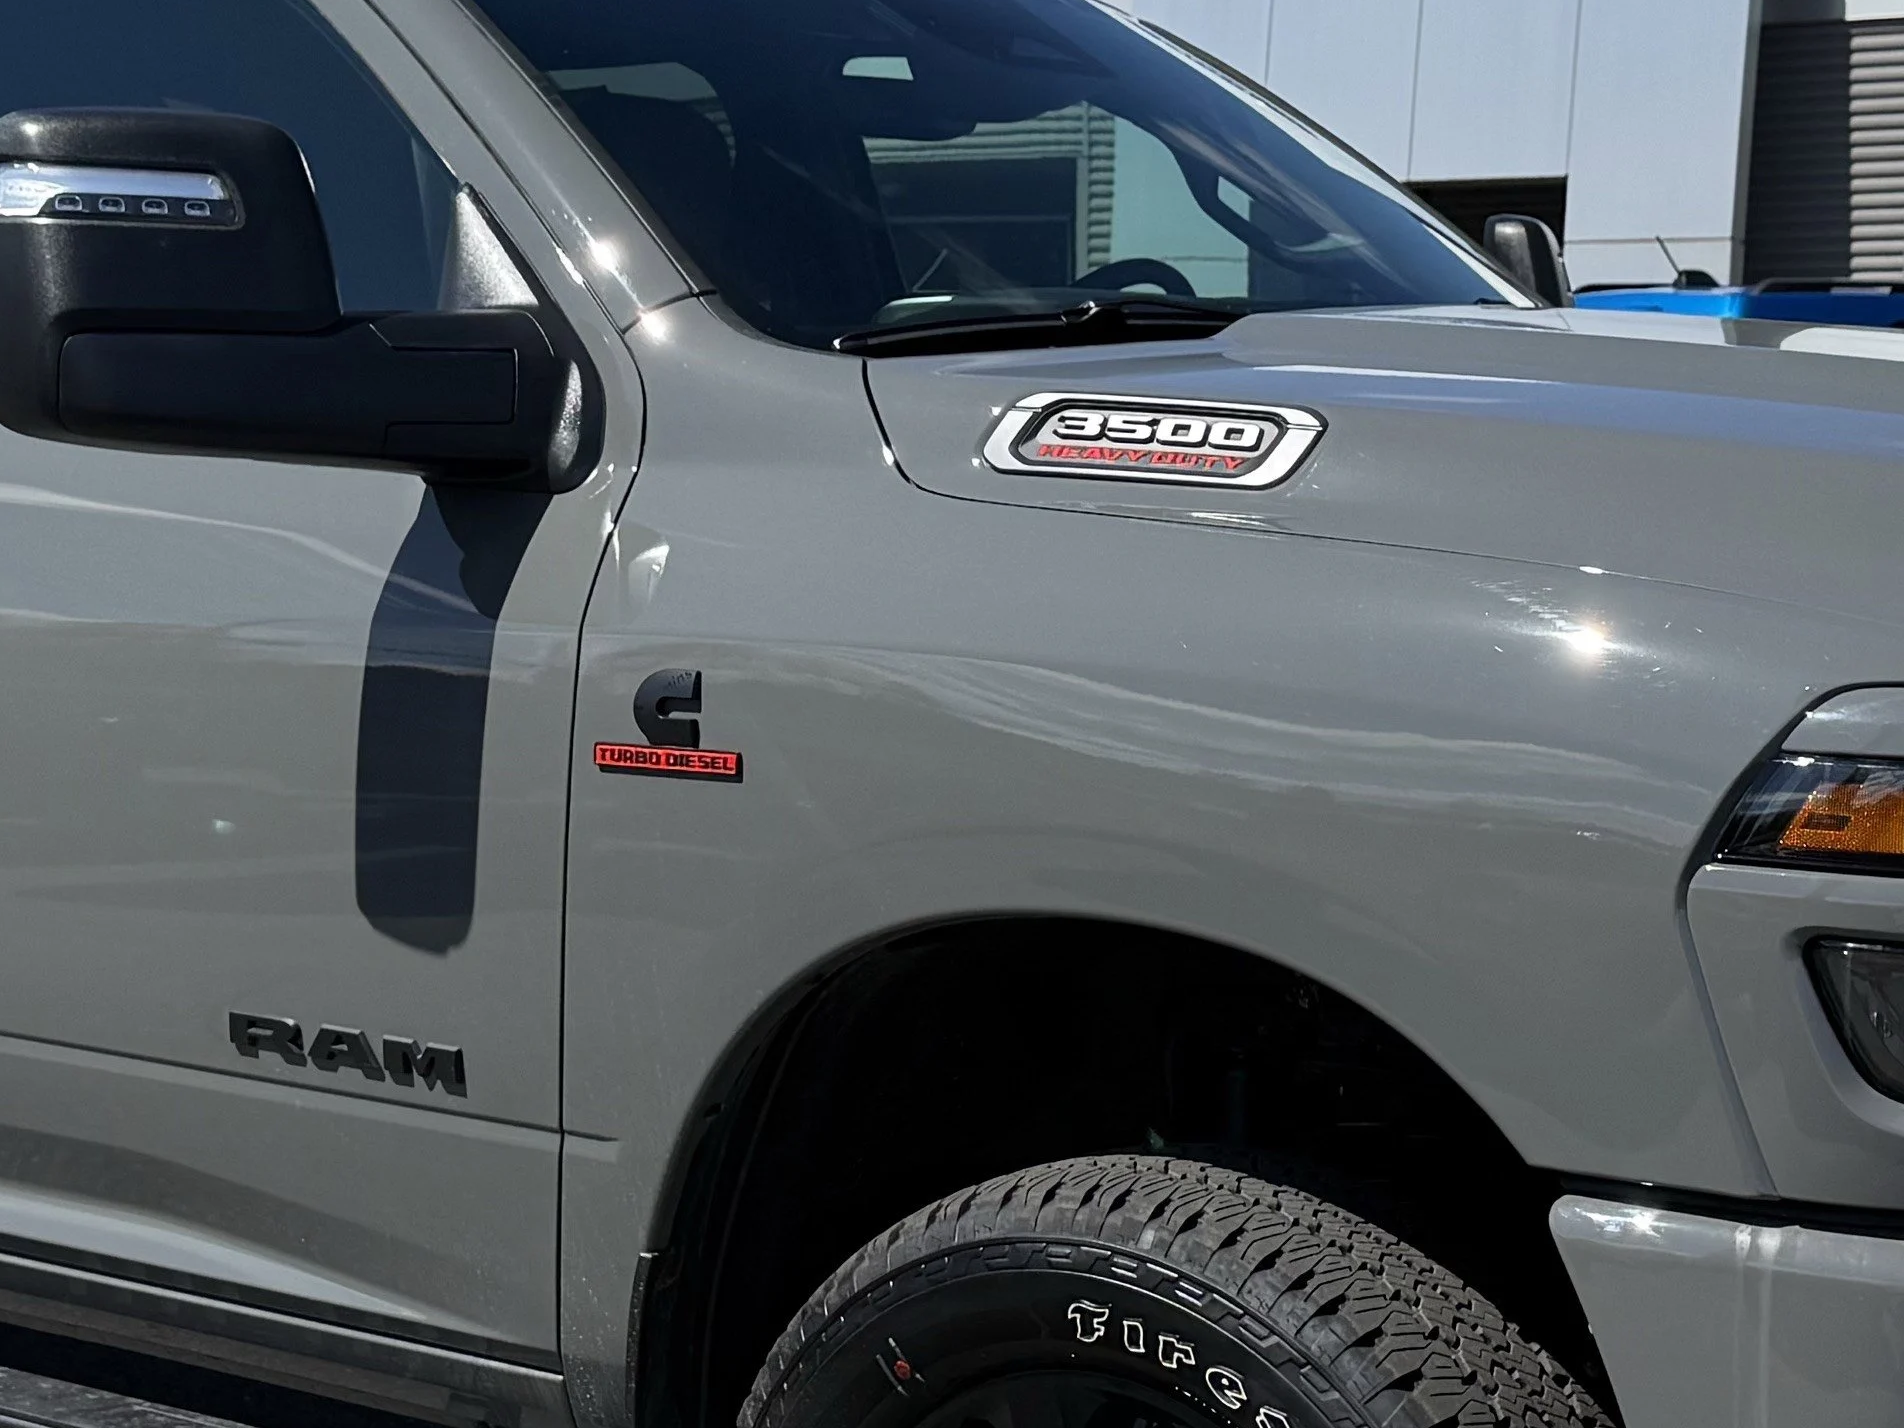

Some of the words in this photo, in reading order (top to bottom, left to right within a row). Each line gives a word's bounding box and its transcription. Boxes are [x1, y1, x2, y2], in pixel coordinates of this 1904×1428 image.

[1053, 412, 1264, 452] 3500
[1038, 444, 1147, 463] HEAVY
[1149, 451, 1247, 470] DUTY
[598, 747, 662, 766] TURBO
[665, 753, 735, 771] DIESEL
[228, 1010, 469, 1099] RAM
